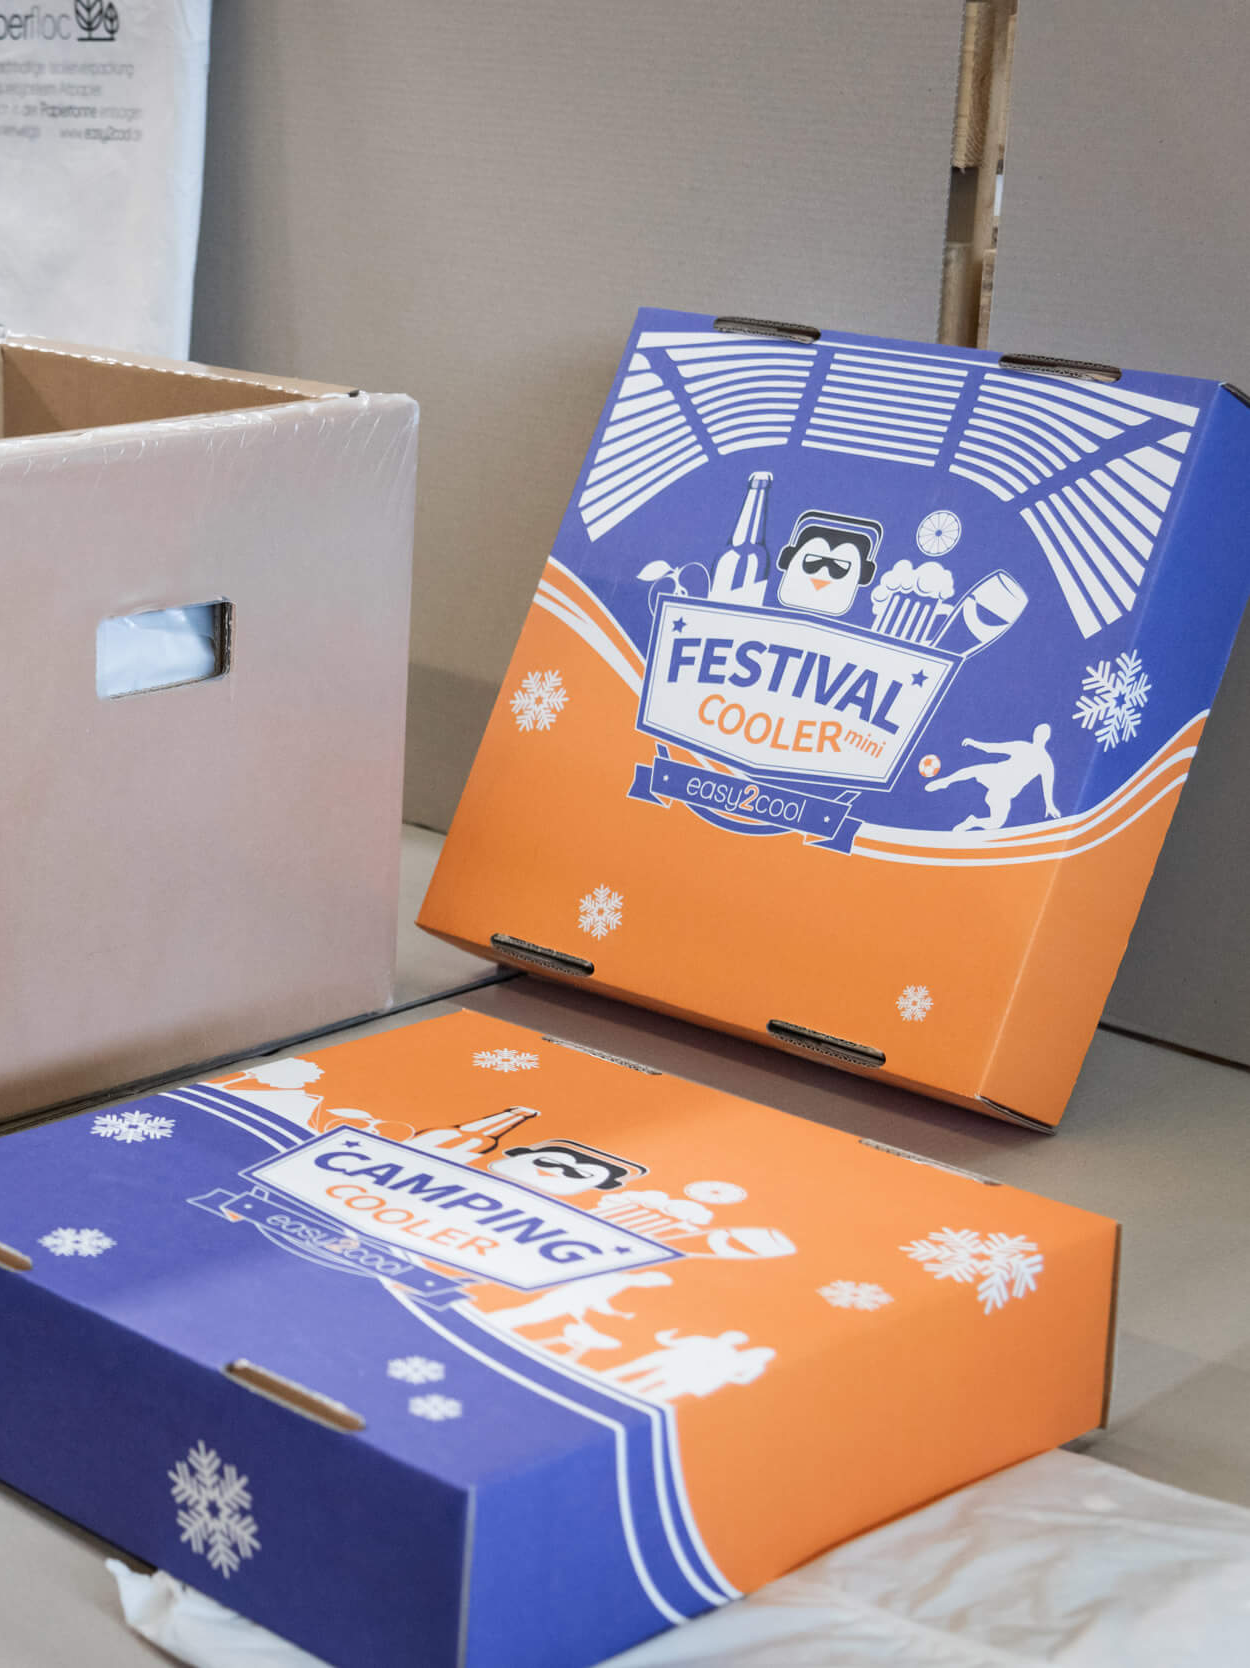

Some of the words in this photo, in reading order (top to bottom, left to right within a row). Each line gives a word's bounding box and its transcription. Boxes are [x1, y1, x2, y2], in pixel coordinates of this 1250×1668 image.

[667, 637, 903, 735] FESTIVAL
[698, 693, 843, 753] COOLER
[844, 726, 887, 760] mini
[686, 775, 807, 823] easy2cool
[314, 1150, 603, 1265] CAMPING
[326, 1184, 502, 1257] COOLER
[266, 1214, 415, 1276] easy2cool
